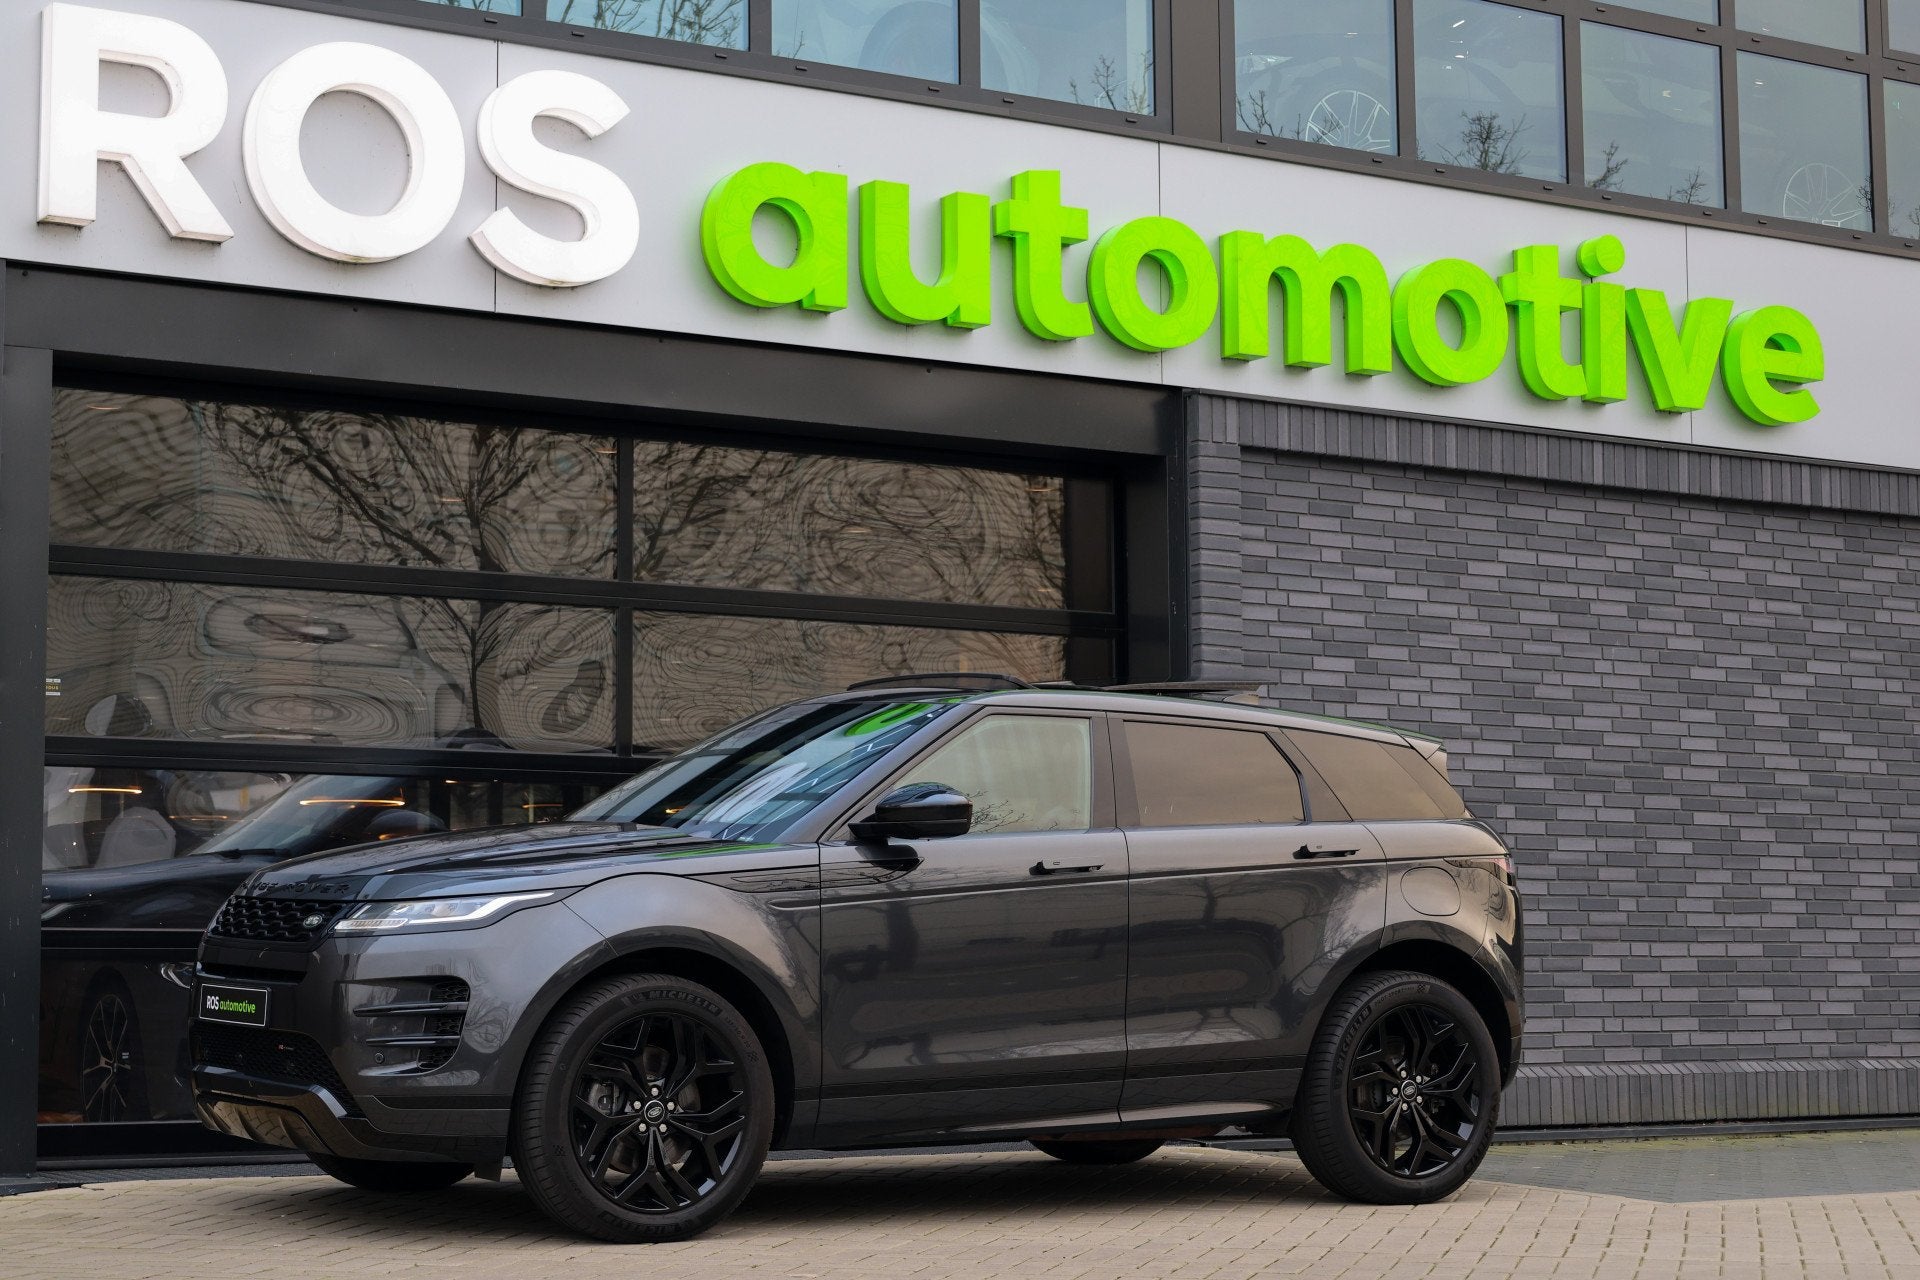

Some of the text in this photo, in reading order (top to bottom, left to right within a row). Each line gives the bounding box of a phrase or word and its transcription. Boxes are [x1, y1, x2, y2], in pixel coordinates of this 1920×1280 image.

[37, 2, 1825, 427] ROS automotive
[206, 996, 256, 1013] ROS automotive
[649, 990, 720, 1015] MICHELIN
